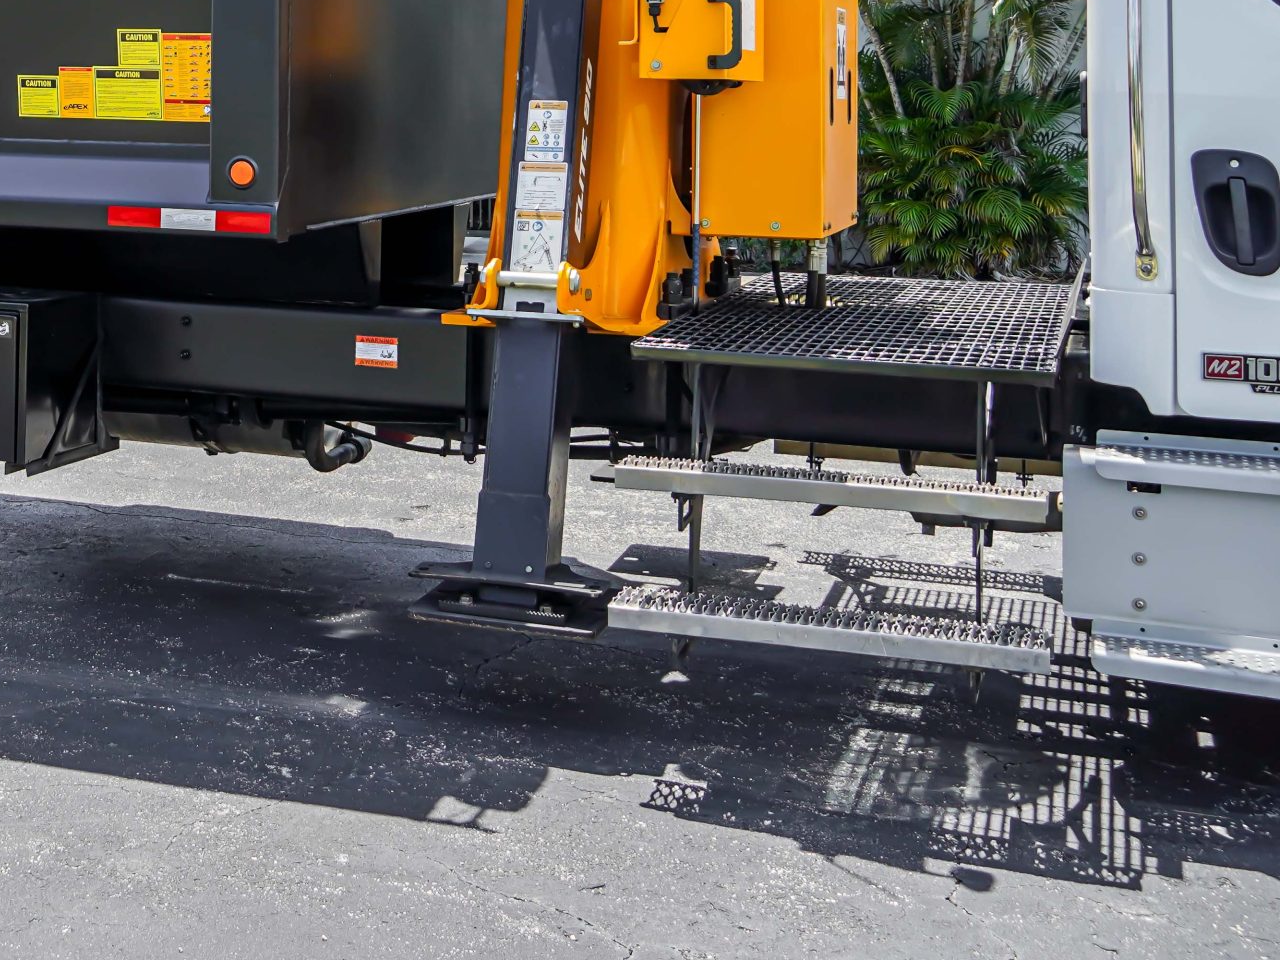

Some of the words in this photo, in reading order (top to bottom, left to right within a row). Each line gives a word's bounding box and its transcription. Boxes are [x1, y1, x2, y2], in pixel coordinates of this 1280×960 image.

[125, 33, 153, 41] CAUTION
[25, 79, 52, 88] CAUTION
[575, 127, 588, 243] ELITE
[583, 57, 593, 126] 910
[1208, 359, 1241, 375] M2
[1246, 357, 1280, 382] 10
